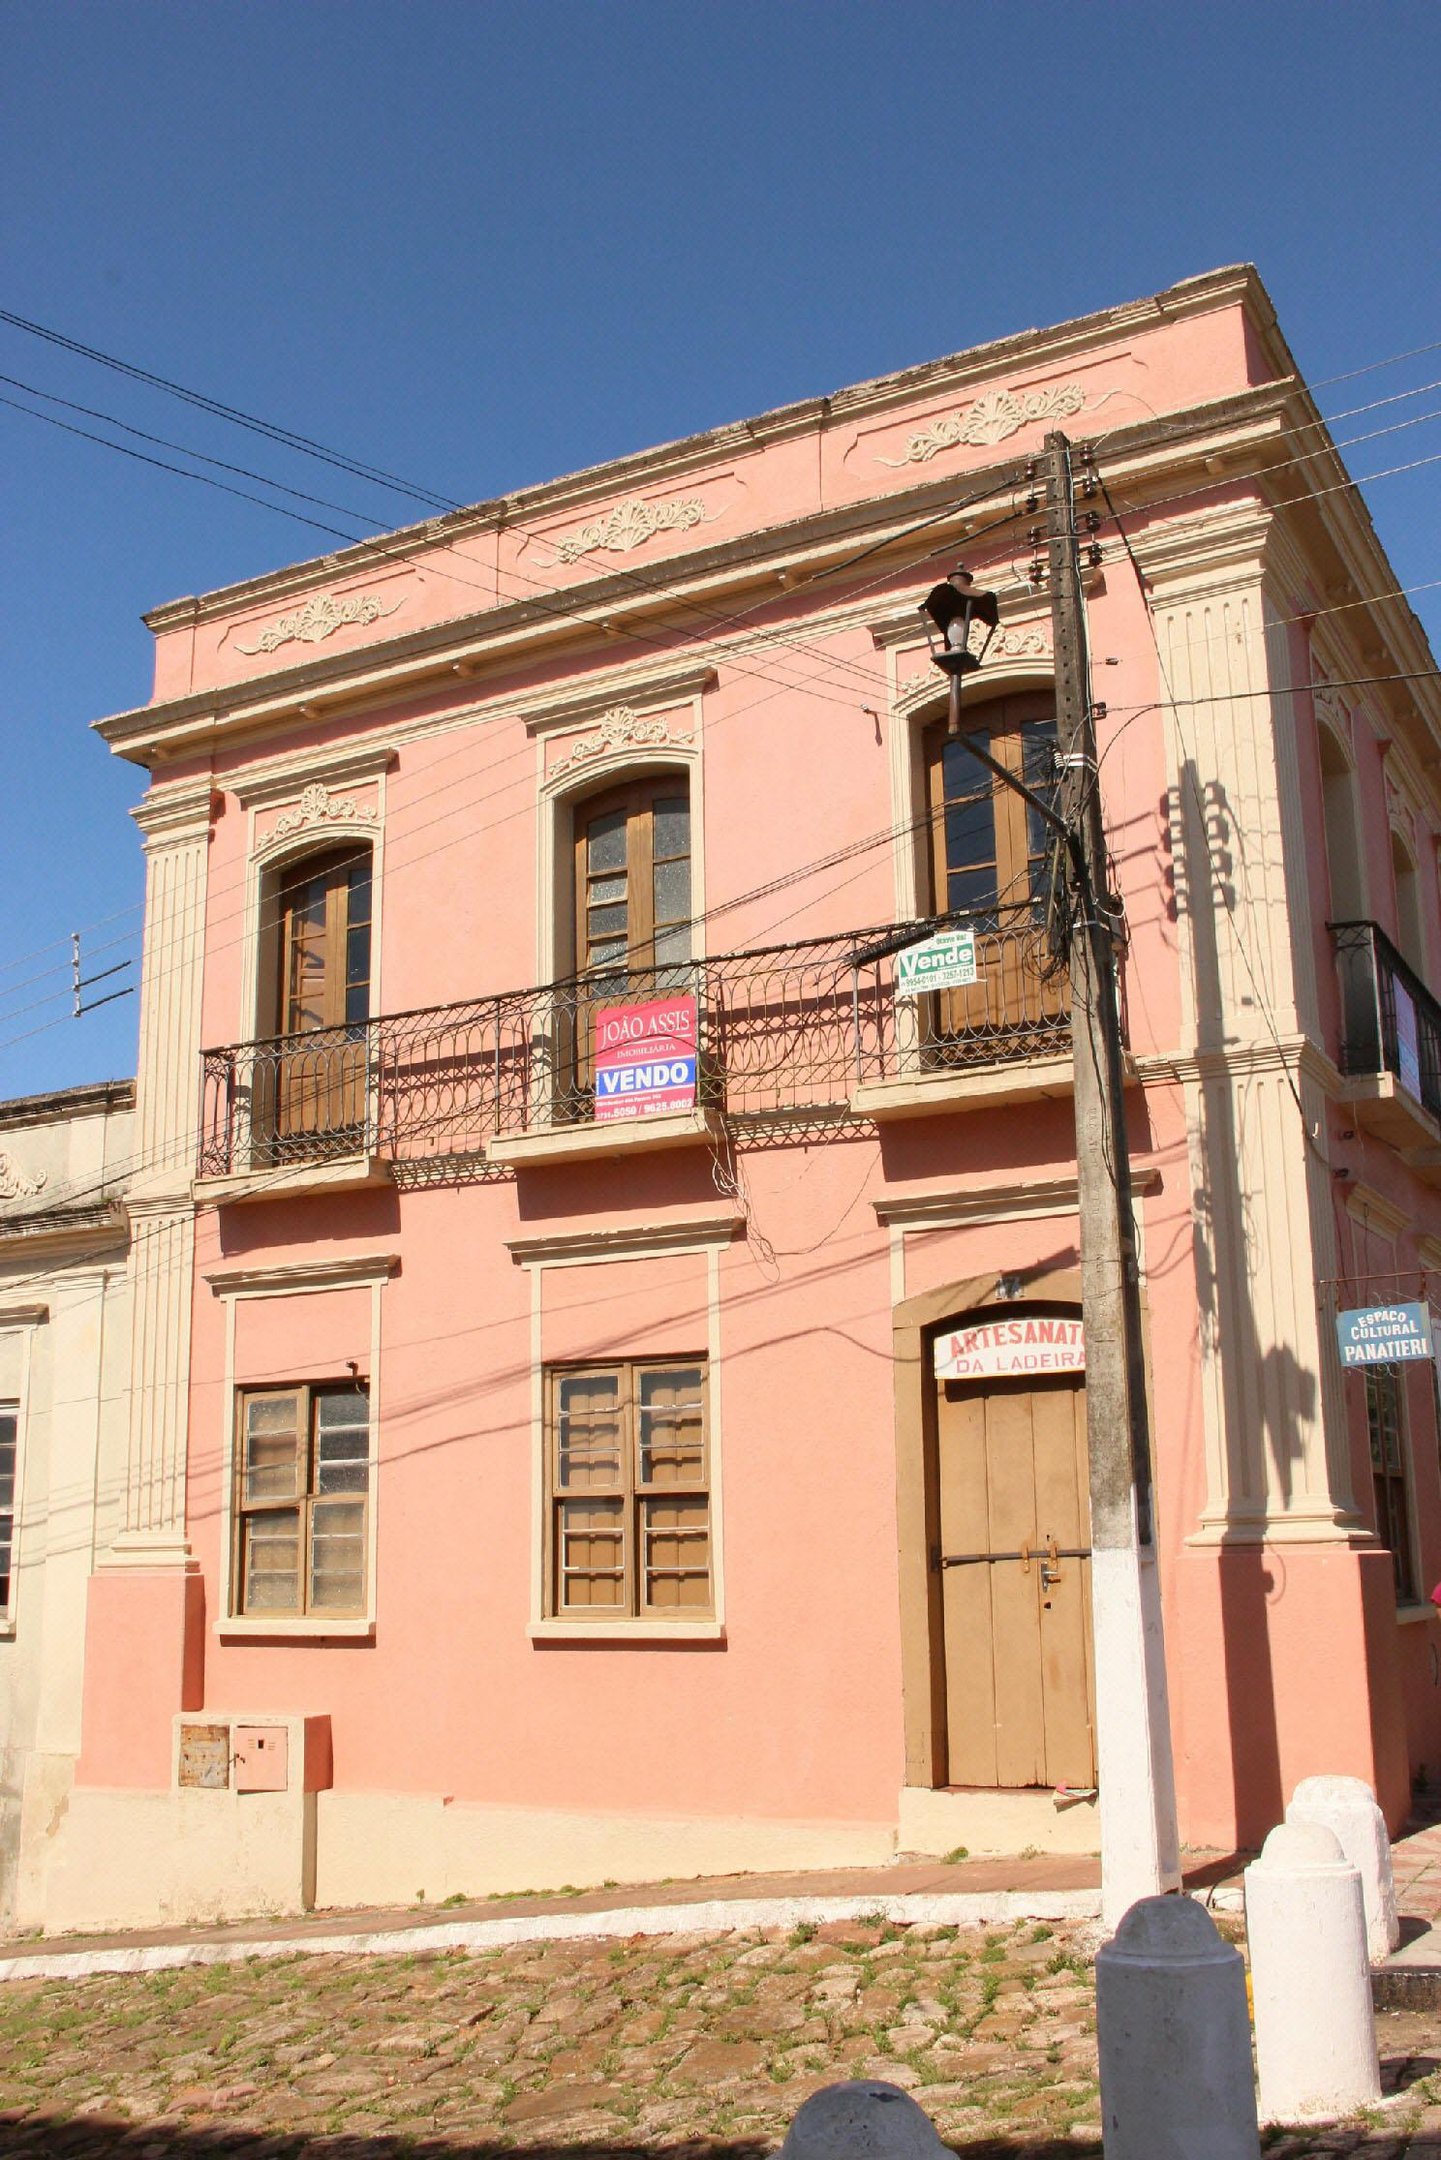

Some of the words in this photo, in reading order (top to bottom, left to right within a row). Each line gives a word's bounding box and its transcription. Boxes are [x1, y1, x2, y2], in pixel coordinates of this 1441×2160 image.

[901, 945, 972, 977] Vende
[601, 1015, 644, 1049] JOÃO
[647, 1009, 690, 1035] ASSIS
[602, 1062, 689, 1093] VENDO
[950, 1320, 1085, 1358] ARTESANAT
[1350, 1319, 1419, 1340] CULTURAL
[1344, 1338, 1428, 1362] PANATIERI
[956, 1358, 984, 1374] DA
